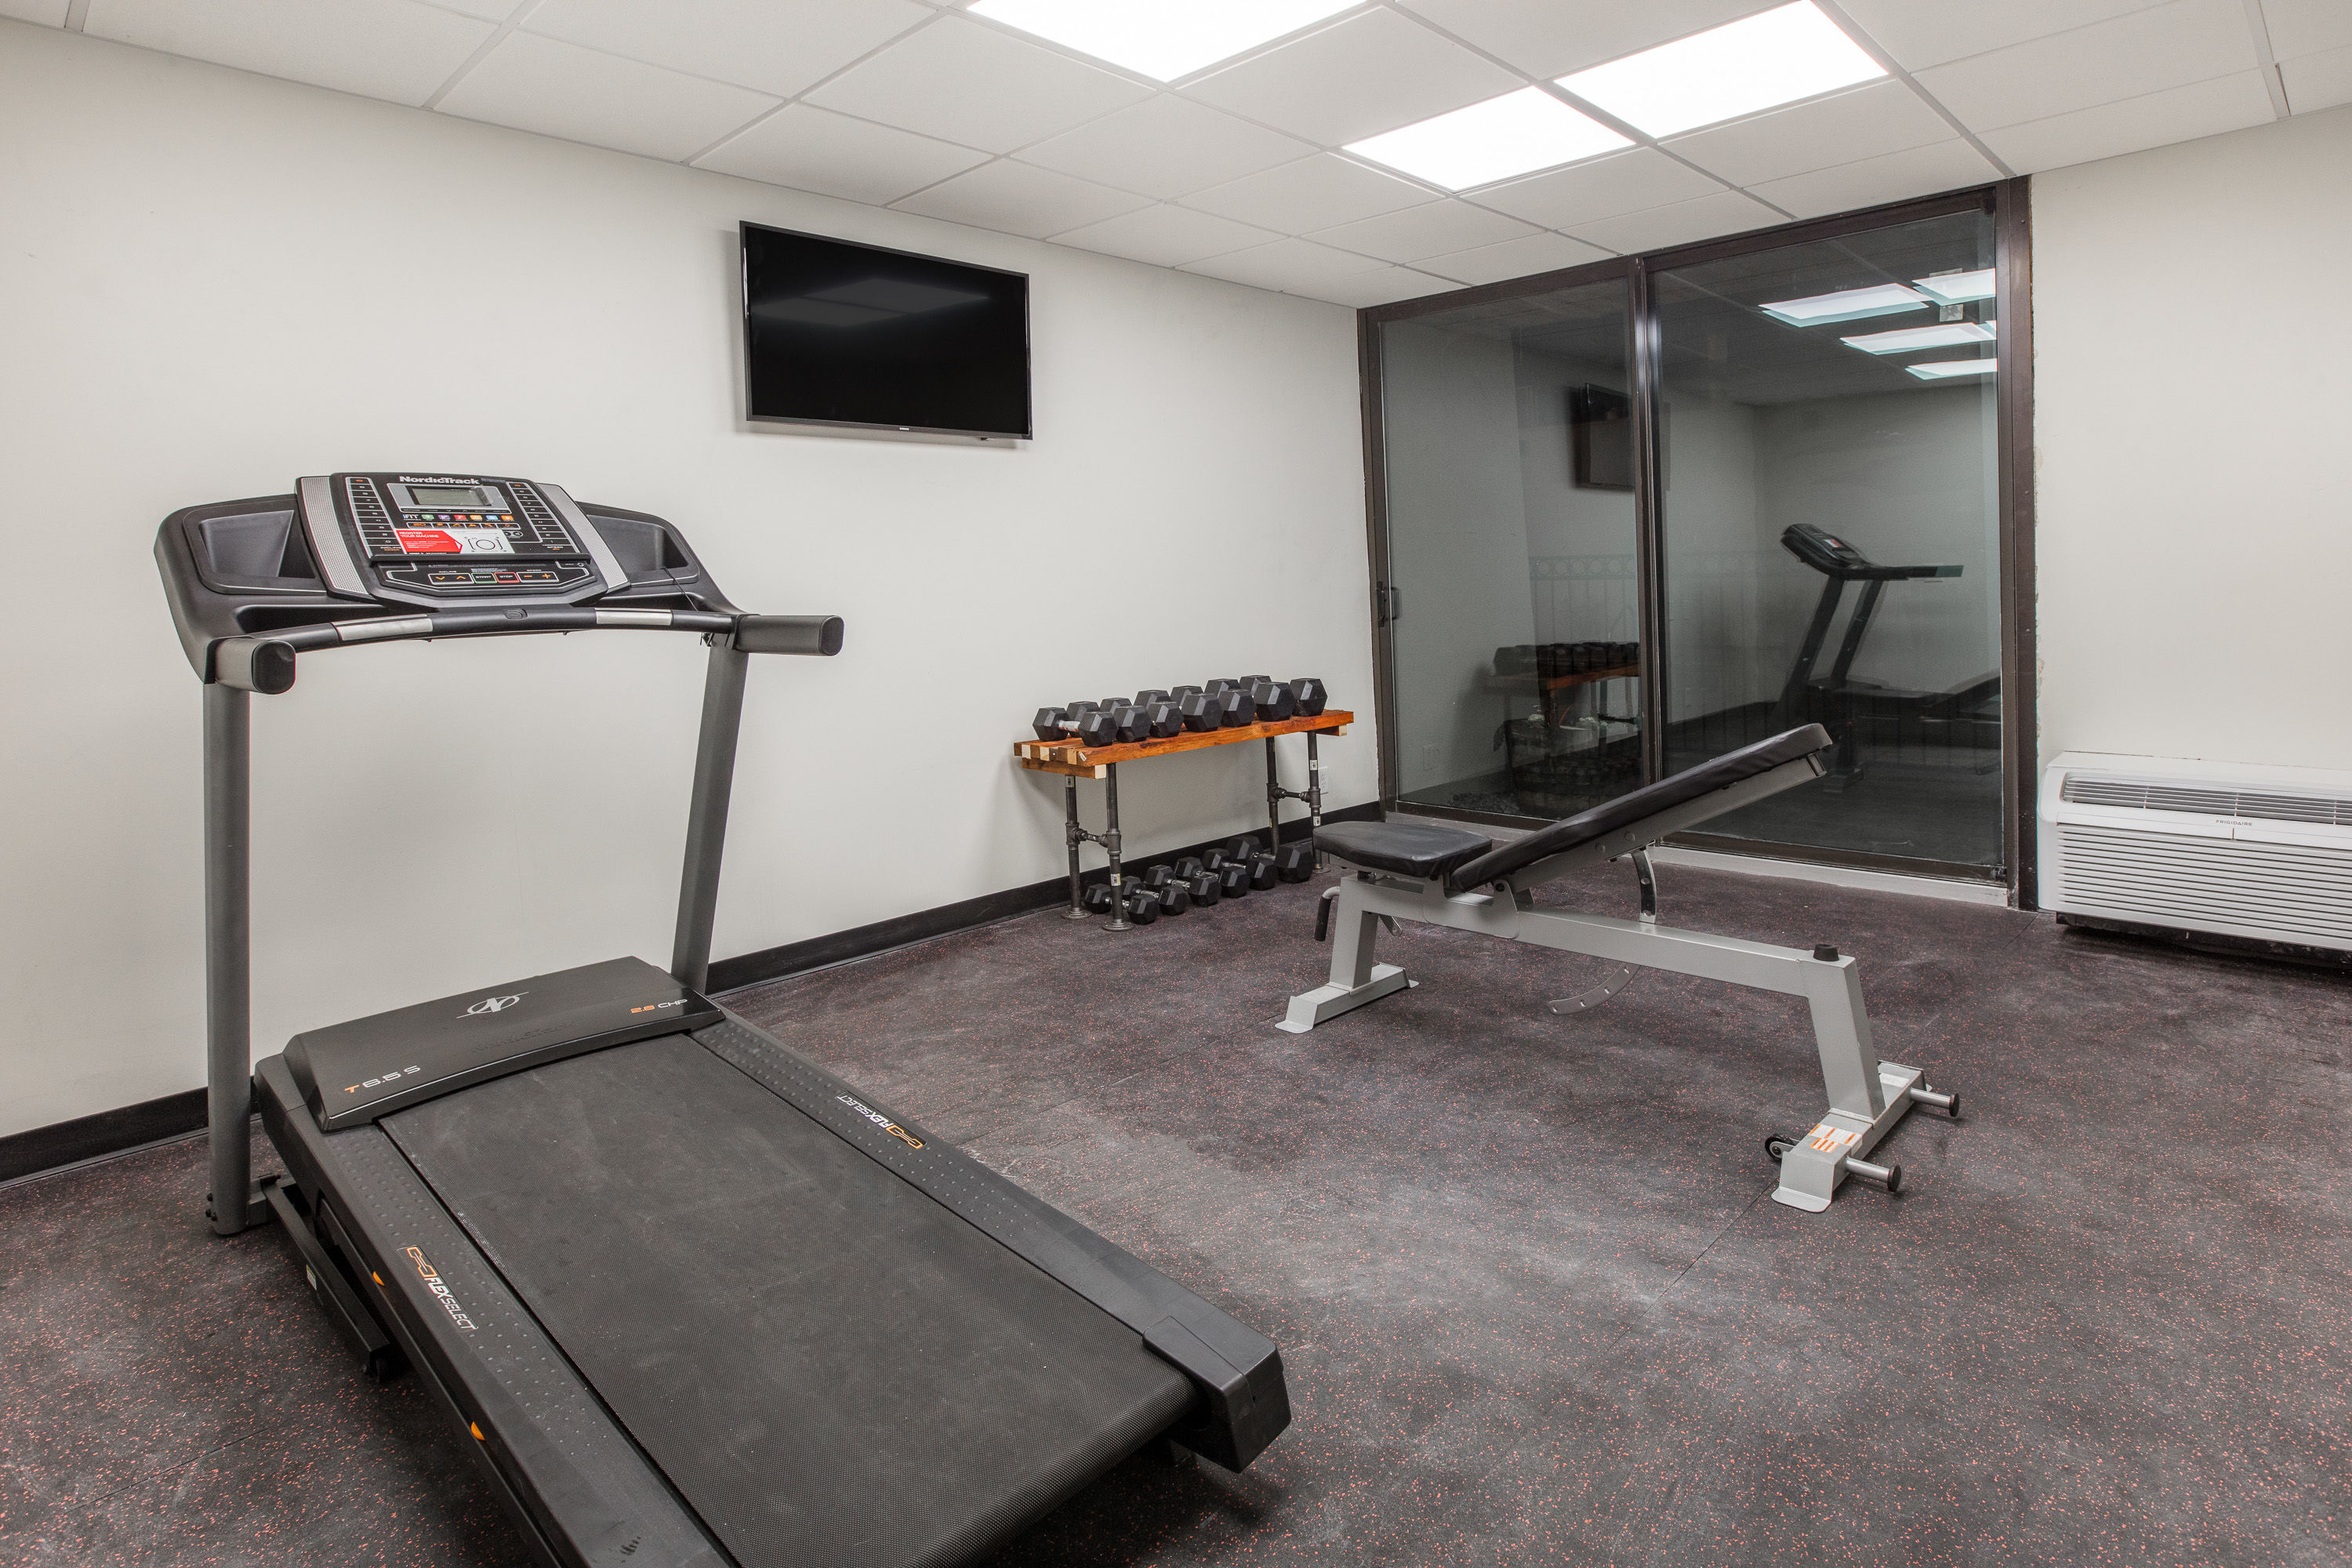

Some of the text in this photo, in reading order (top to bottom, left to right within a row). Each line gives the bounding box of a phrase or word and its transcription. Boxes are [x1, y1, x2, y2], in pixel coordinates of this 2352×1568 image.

[398, 476, 481, 485] NordicTrack
[658, 999, 688, 1008] CHP
[835, 1095, 895, 1128] FLEXSELECT
[424, 1277, 479, 1330] FLEXSELECT
